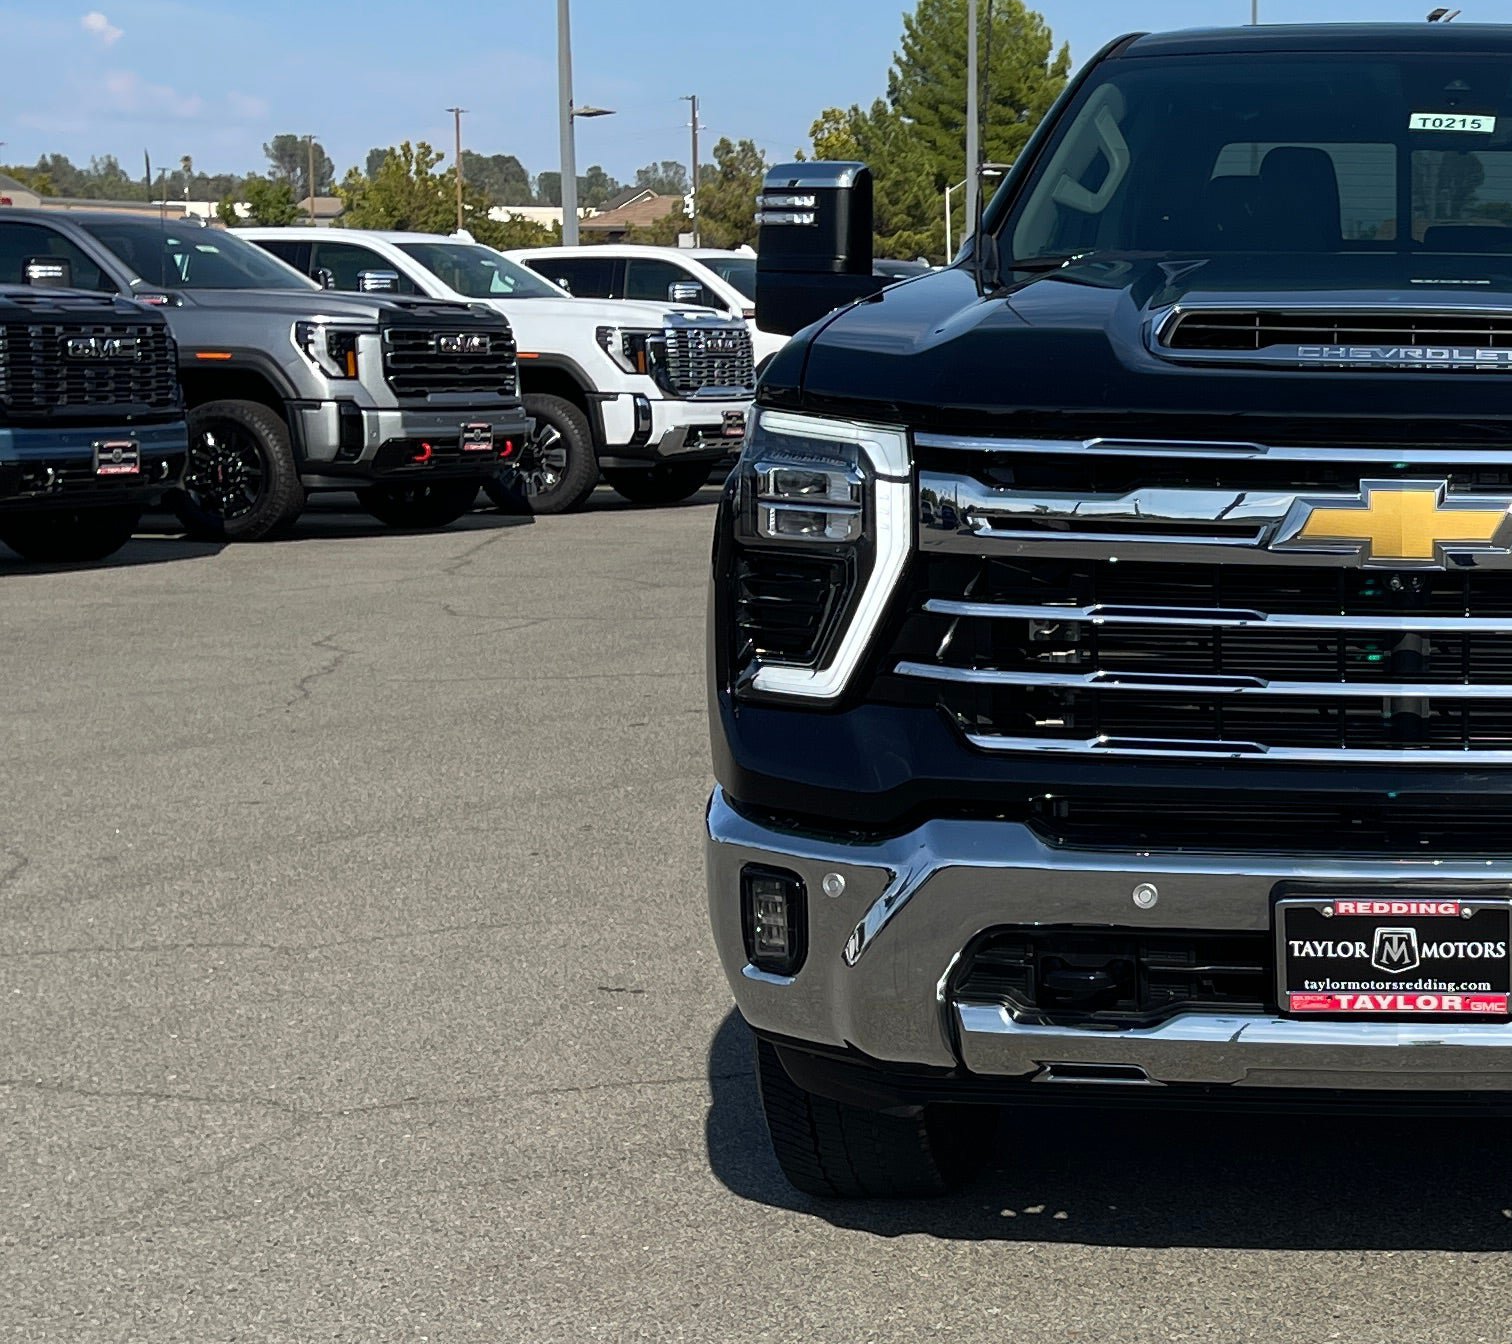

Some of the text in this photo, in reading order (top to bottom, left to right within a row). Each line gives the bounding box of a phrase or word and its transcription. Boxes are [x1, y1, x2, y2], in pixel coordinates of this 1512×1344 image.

[1418, 117, 1482, 129] T0215
[1338, 902, 1457, 914] REDDING
[1289, 940, 1370, 958] TAYLOR
[1420, 941, 1506, 958] MOTORS
[1304, 978, 1491, 991] taylormotorsredding.com
[1335, 995, 1463, 1010] TAYLOR
[1470, 1001, 1506, 1012] GMC
